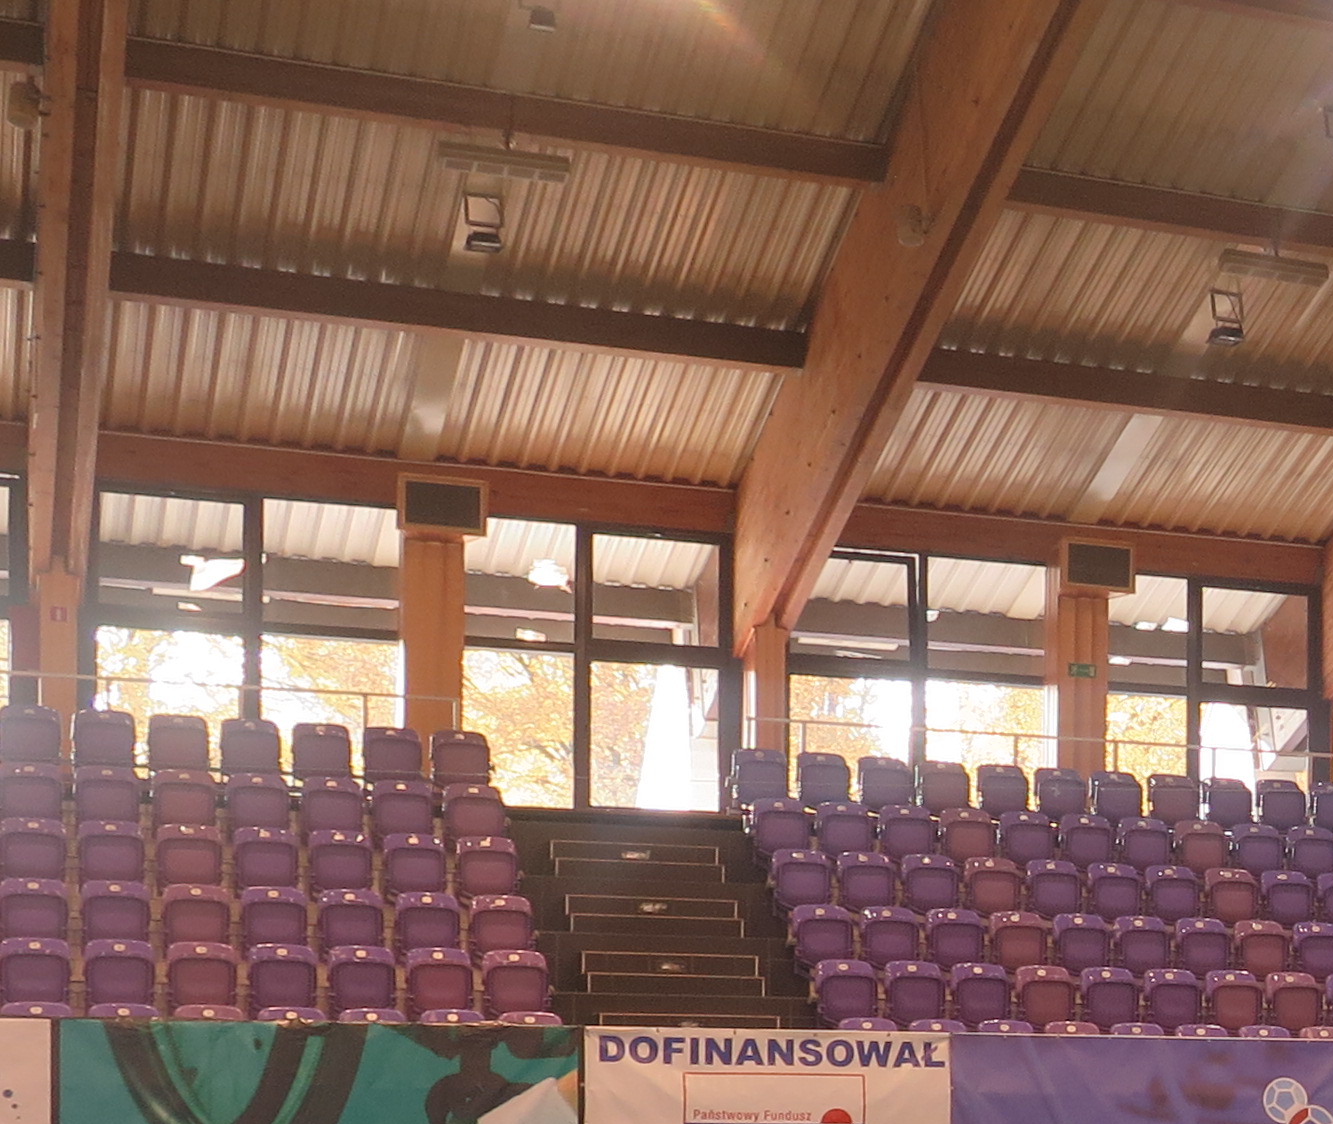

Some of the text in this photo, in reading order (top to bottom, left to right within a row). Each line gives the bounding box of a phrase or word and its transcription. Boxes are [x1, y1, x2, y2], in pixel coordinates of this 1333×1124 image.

[599, 1035, 946, 1068] DOFINANSOWAŁ
[693, 1109, 812, 1122] Państwowy Fundusz
